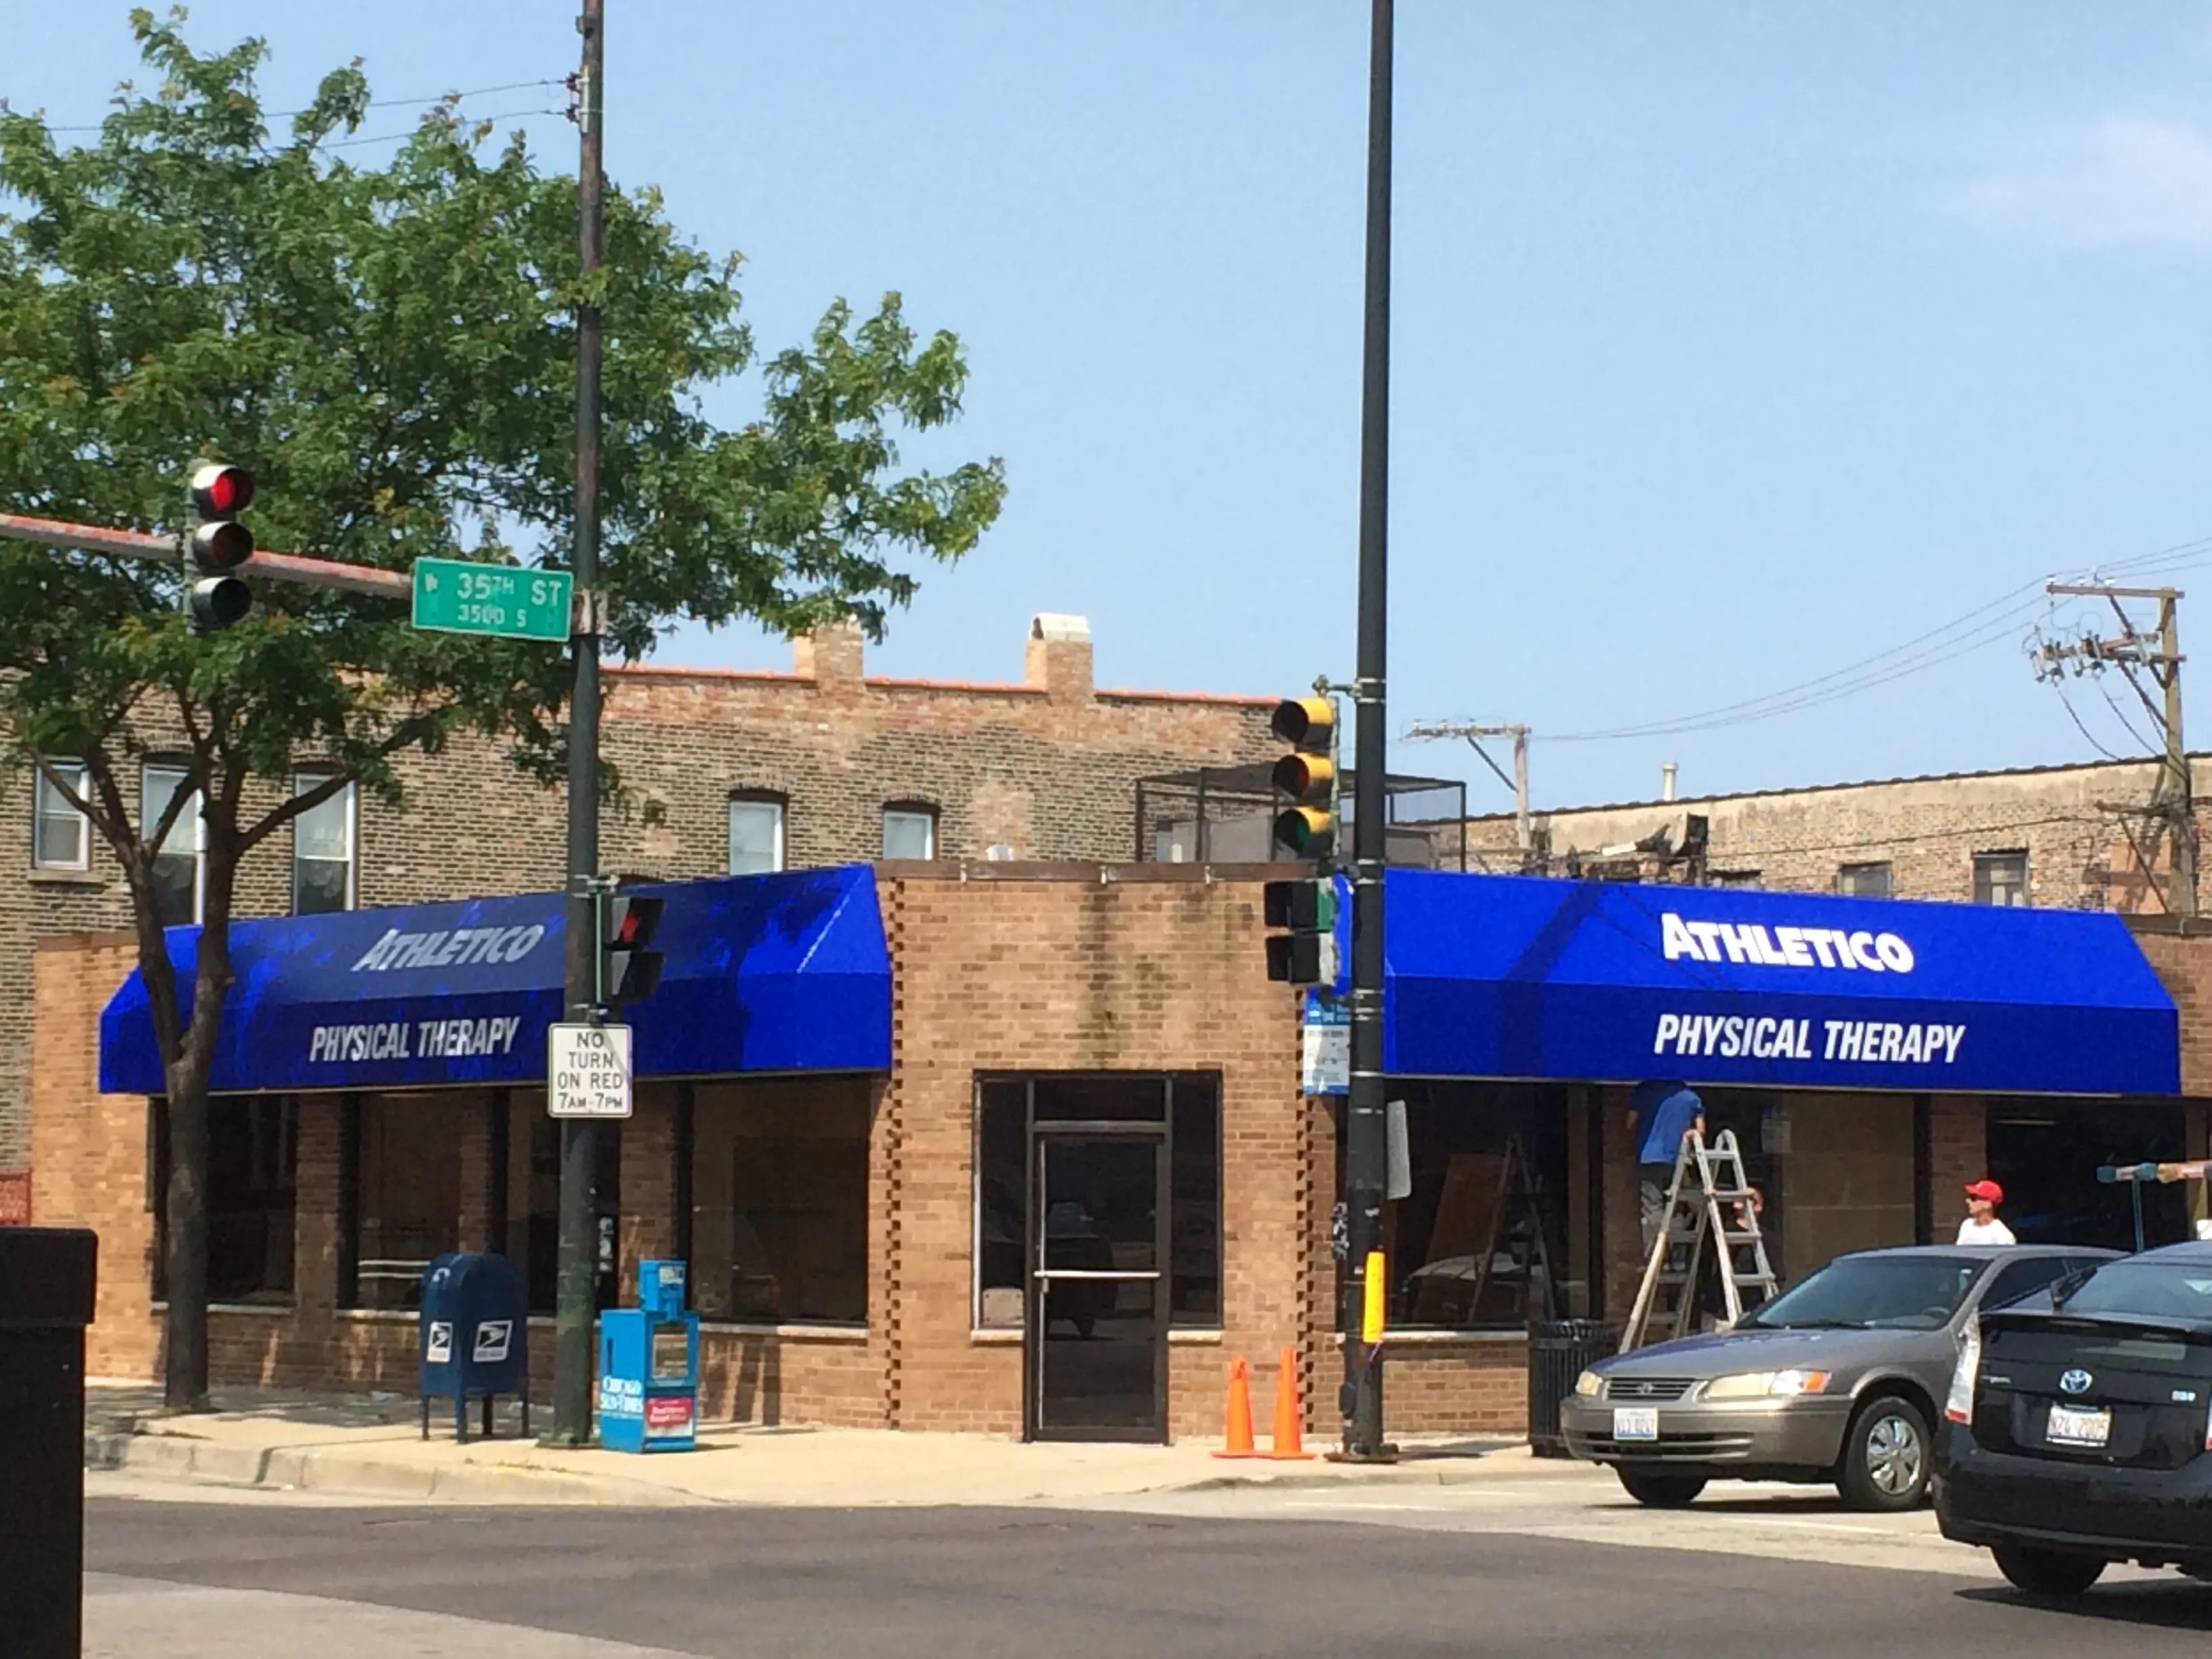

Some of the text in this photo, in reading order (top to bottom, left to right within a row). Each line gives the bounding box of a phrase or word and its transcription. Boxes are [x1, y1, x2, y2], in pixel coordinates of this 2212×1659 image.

[457, 573, 515, 600] 35TH
[531, 579, 562, 607] ST
[516, 609, 527, 628] S
[350, 924, 545, 972] ATHLETICO
[1660, 912, 1914, 973] ATHLETICO
[309, 1017, 521, 1063] PHYSICAL THERAPY
[577, 1031, 605, 1048] NO
[1654, 1014, 1967, 1063] PHYSICAL THERAPY
[568, 1051, 615, 1069] TURN
[557, 1071, 623, 1090] ON RED
